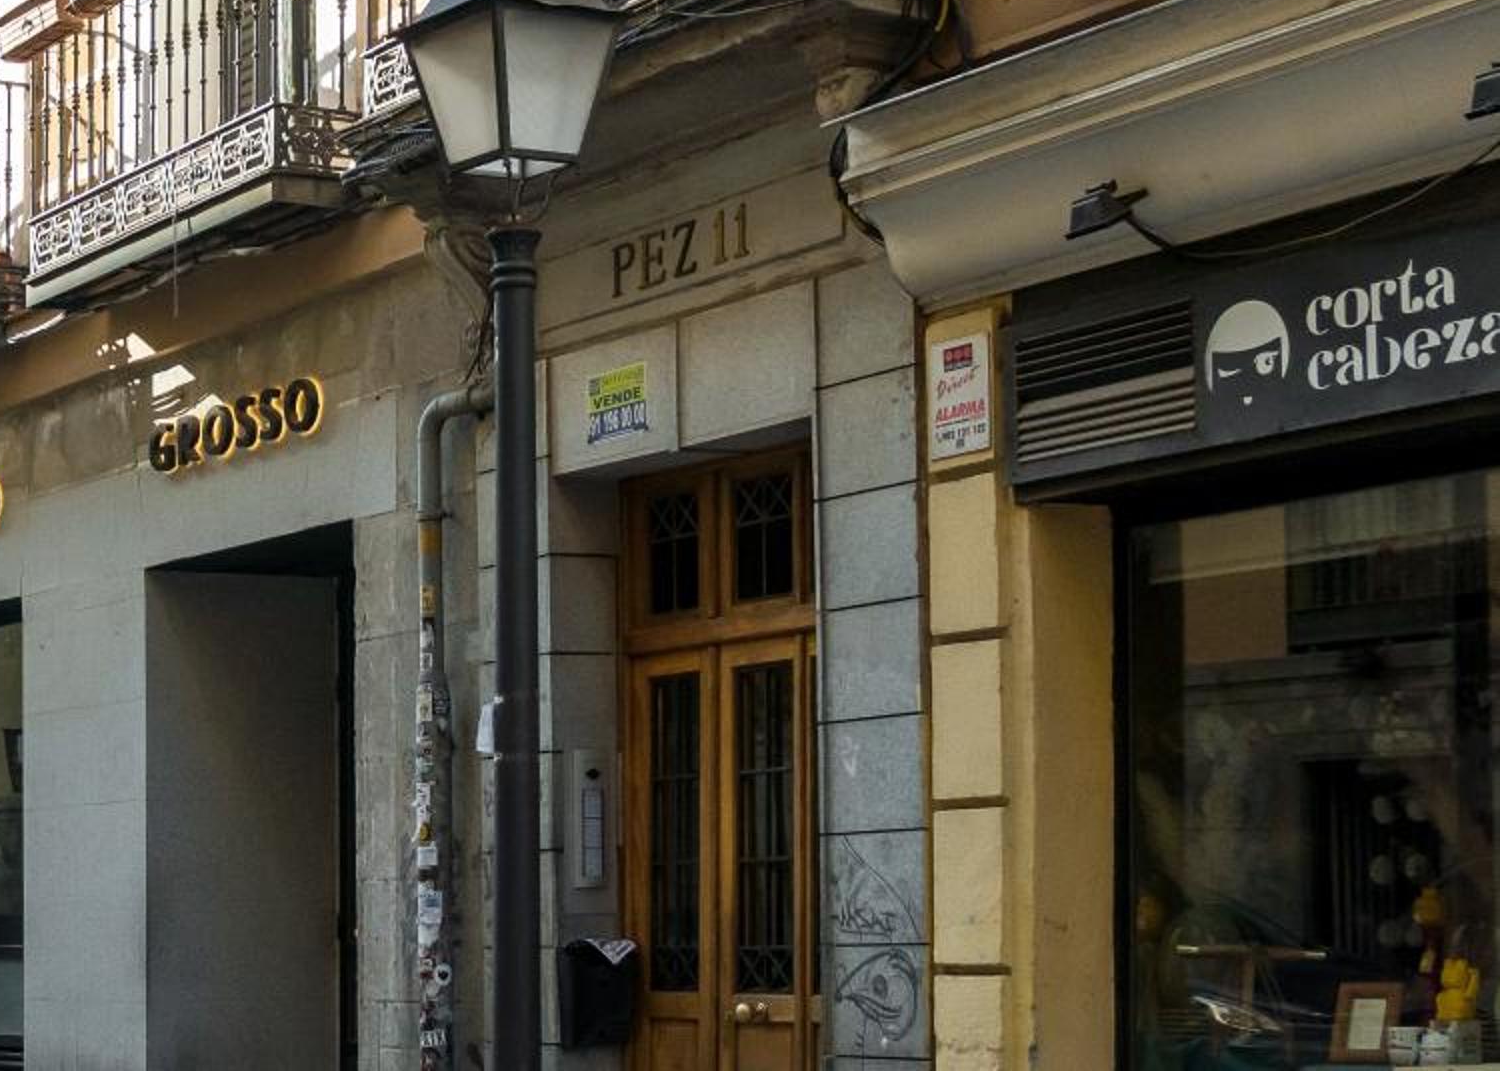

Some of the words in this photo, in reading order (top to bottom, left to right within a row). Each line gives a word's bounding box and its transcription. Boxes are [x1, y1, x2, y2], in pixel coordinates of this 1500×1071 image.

[611, 219, 697, 299] PEZ
[712, 202, 750, 265] 11
[1305, 259, 1456, 336] corta
[1307, 312, 1500, 390] cabeza
[148, 376, 323, 472] GROSSO
[593, 386, 641, 410] VENDE
[936, 399, 985, 423] ALARMA
